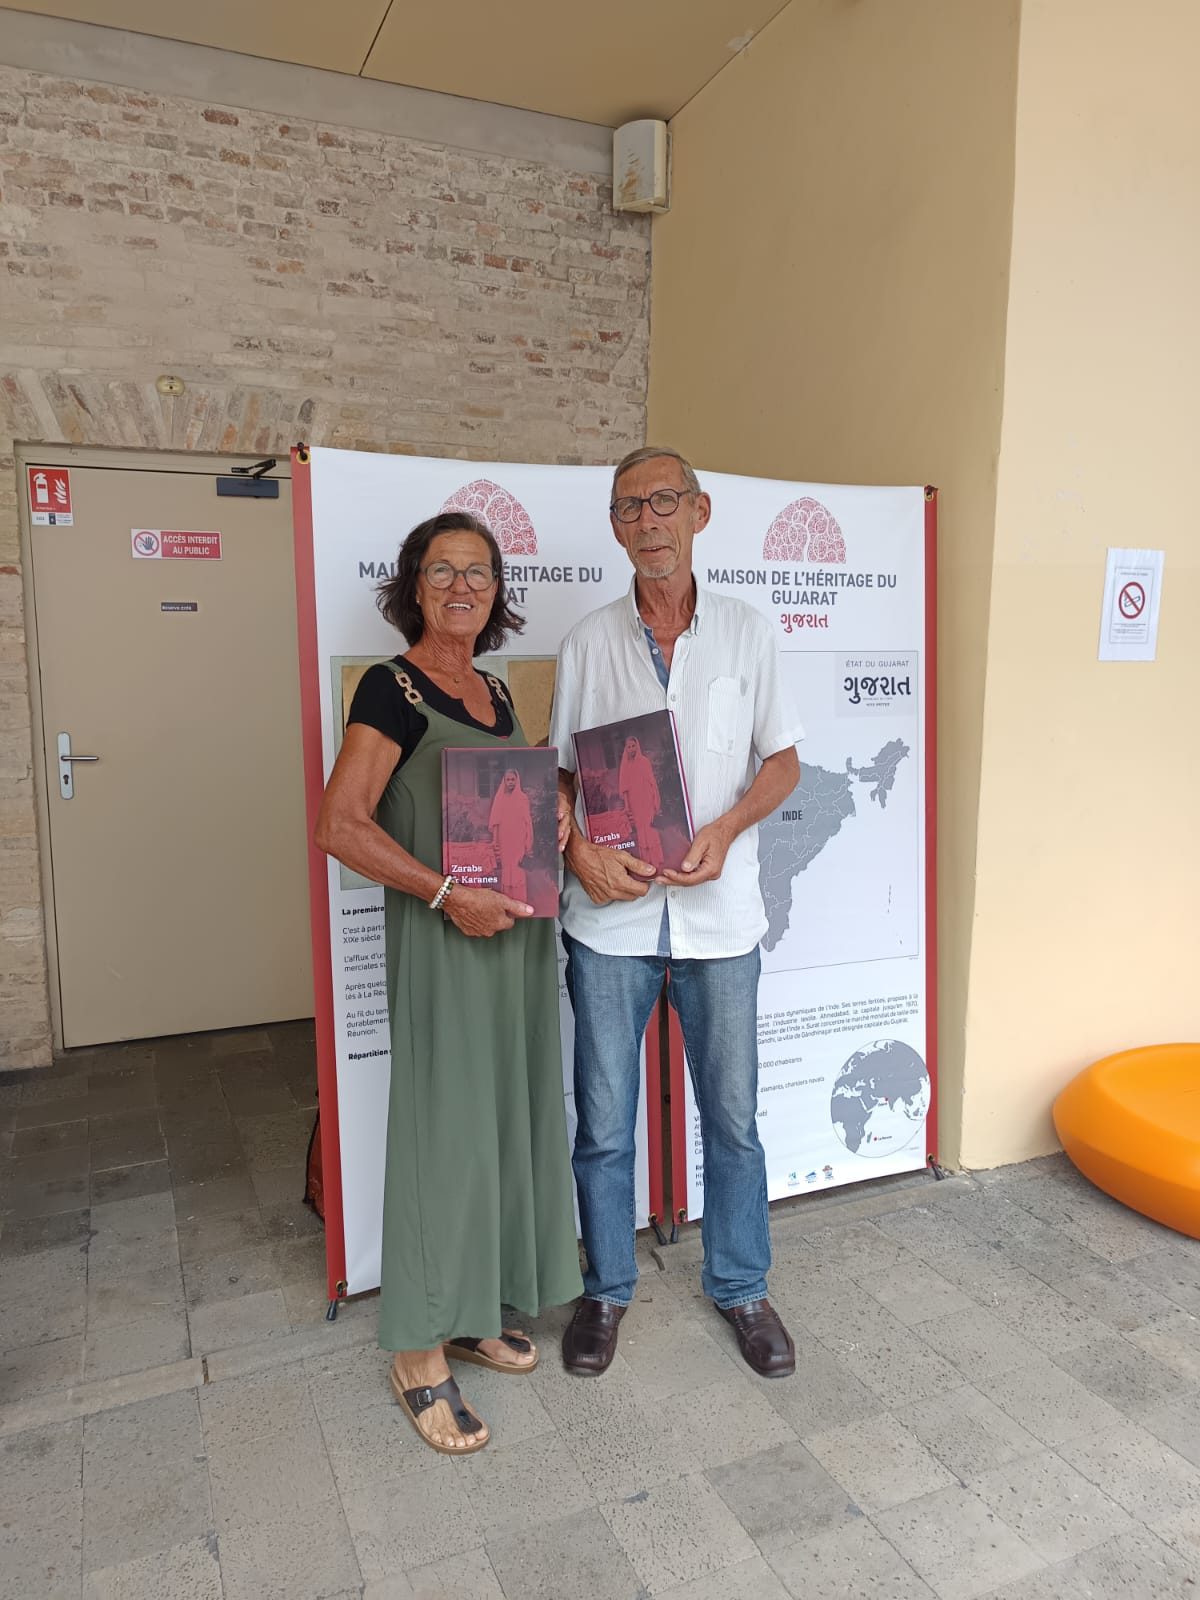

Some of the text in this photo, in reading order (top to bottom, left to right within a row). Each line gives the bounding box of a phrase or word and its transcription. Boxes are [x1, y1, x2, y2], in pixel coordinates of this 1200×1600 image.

[163, 535, 218, 544] ACCÈS INTERDIT
[184, 546, 210, 555] PUBLIC
[359, 561, 603, 582] MAI ÉRITAGE DU
[708, 568, 897, 588] MAISON DE L'HÉRITAGE DU
[772, 590, 838, 606] GUJARAT
[780, 613, 829, 634] ગુજરાત
[846, 660, 862, 668] ÉTAT
[844, 676, 912, 704] ગુજરાત
[782, 810, 803, 822] INDE
[594, 832, 620, 844] Zarabs
[606, 840, 636, 850] aranes
[451, 864, 482, 873] Zarabs
[461, 876, 498, 884] Karanes
[344, 962, 378, 972] merciales
[345, 982, 366, 991] Après
[346, 1018, 389, 1028] durablemen
[348, 1049, 388, 1060] Répartition
